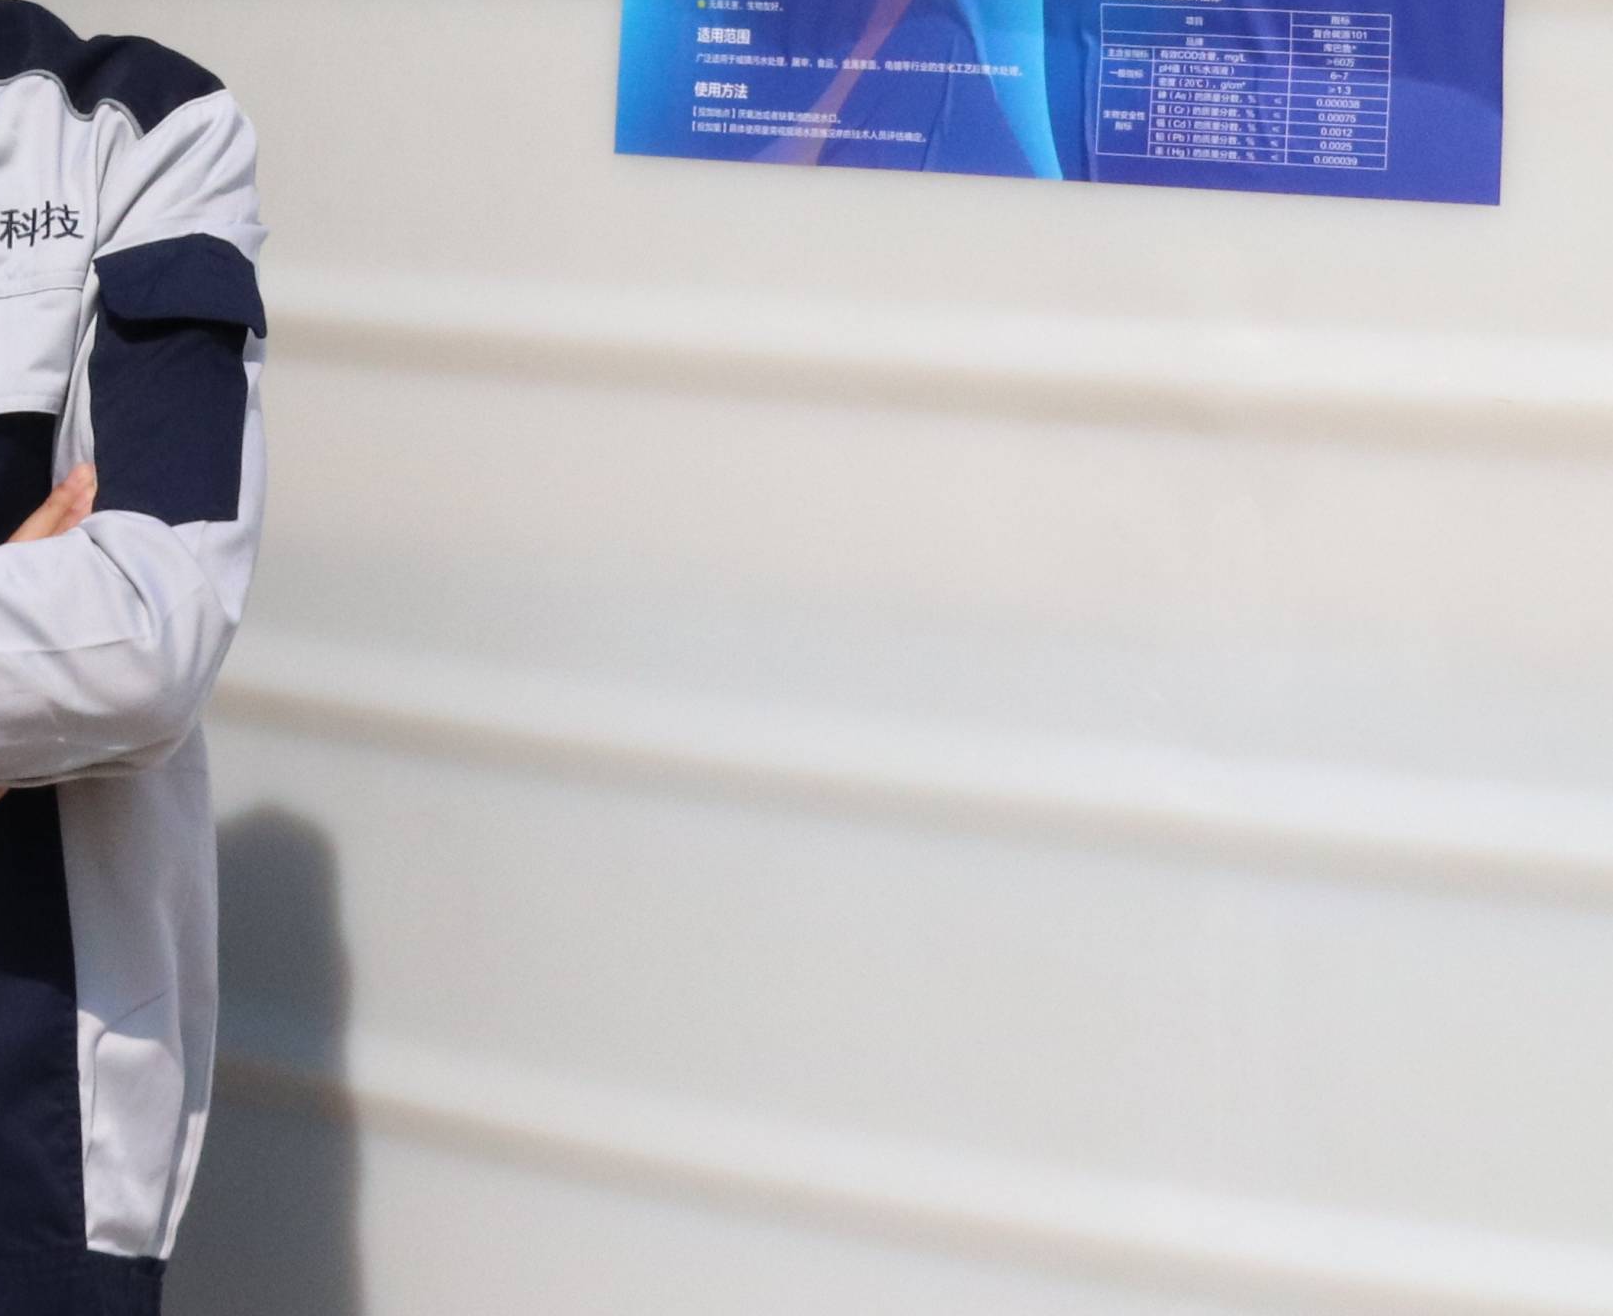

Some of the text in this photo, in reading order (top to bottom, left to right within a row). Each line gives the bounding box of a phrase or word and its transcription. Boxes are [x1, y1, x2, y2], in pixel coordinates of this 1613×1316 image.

[697, 27, 751, 45] 适用范围
[1312, 29, 1368, 40] 复合碳源101
[694, 81, 748, 100] 使用方法
